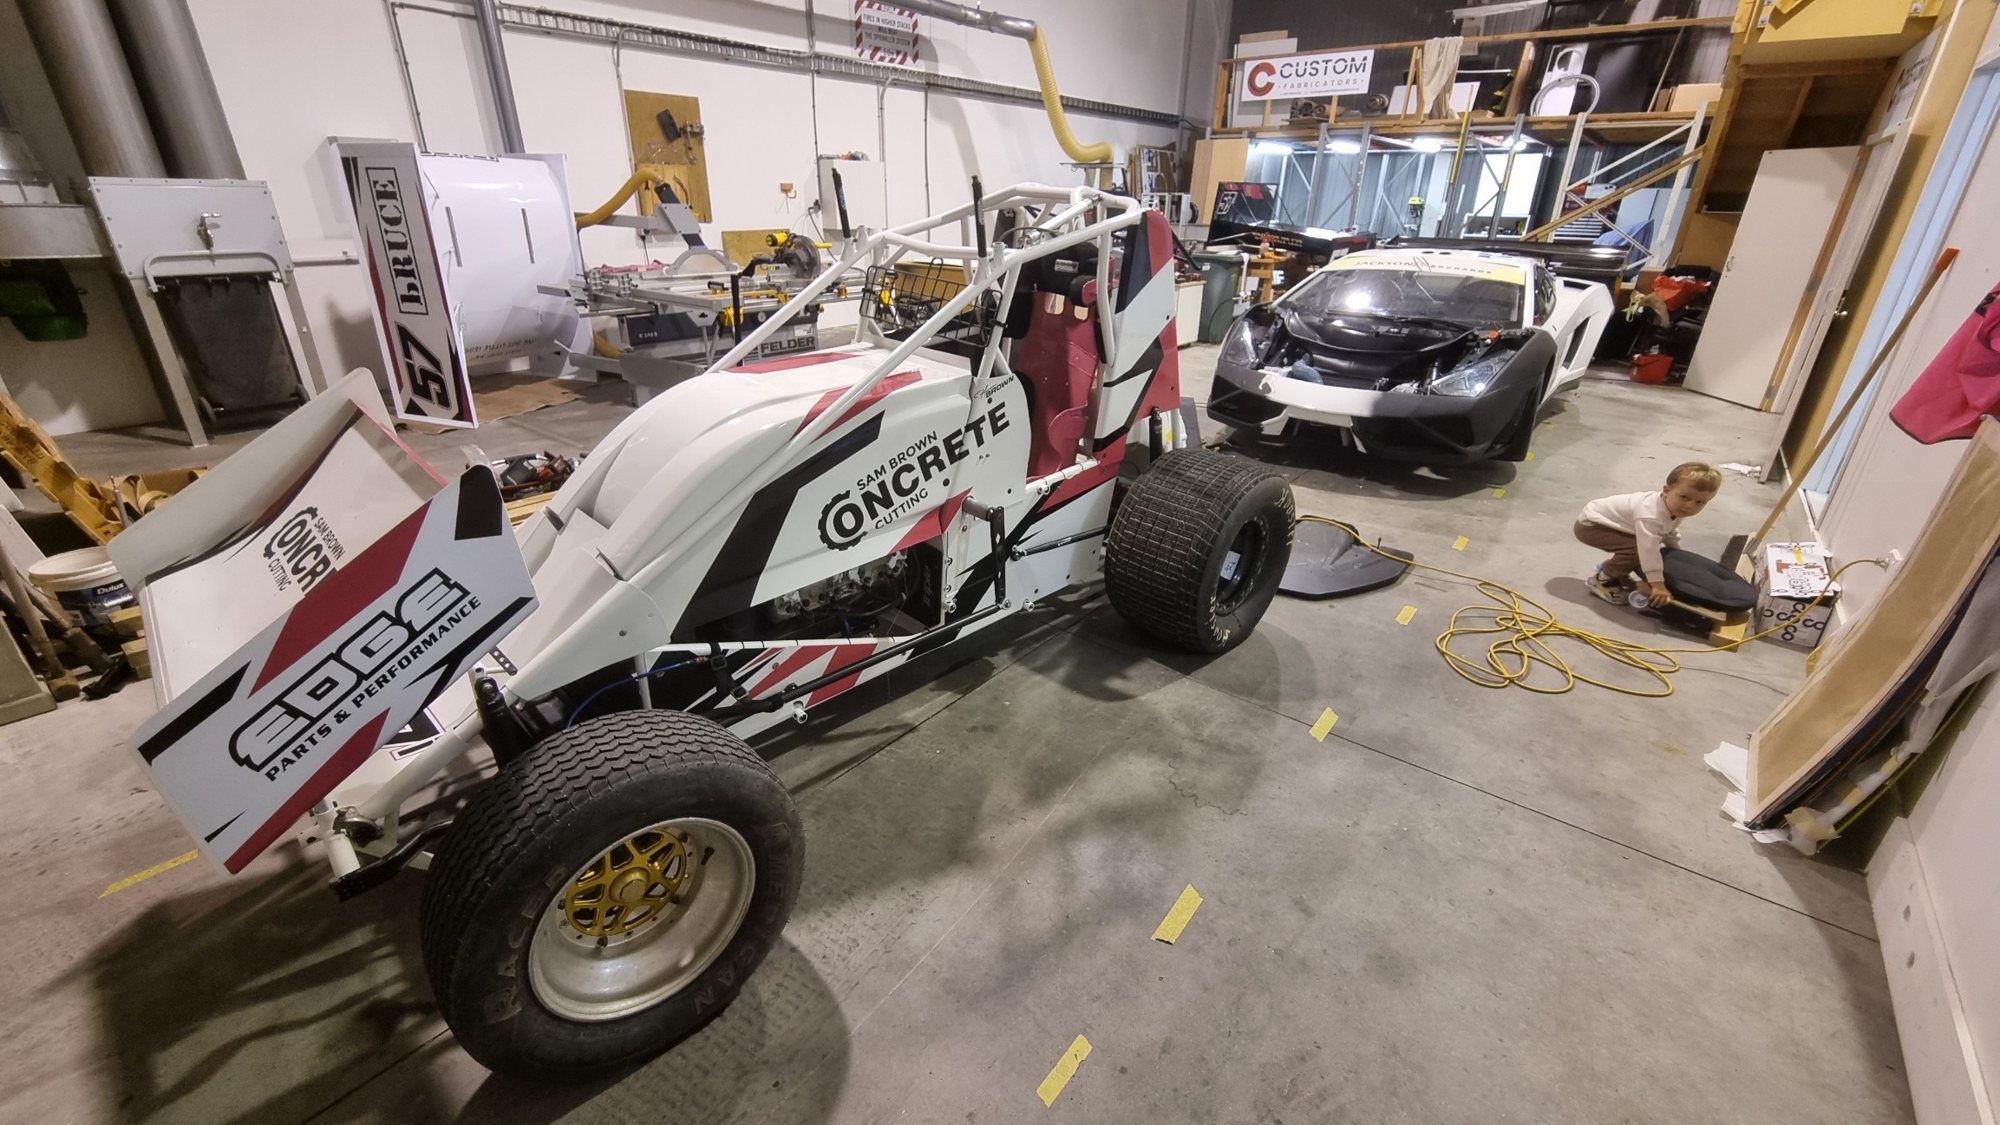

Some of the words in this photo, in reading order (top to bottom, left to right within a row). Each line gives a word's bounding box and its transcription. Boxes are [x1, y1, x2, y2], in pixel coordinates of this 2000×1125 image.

[1280, 56, 1368, 78] CUSTOM
[395, 321, 452, 410] 57
[761, 336, 815, 353] FELDER
[985, 375, 1014, 398] BROWN
[856, 464, 887, 490] SAM
[889, 430, 938, 470] BROWN
[875, 488, 929, 530] CUTTING
[314, 517, 330, 537] SAM
[322, 529, 345, 560] BROWN
[96, 582, 124, 595] Dulux
[268, 558, 292, 591] CUTTING
[228, 566, 471, 772] EDGE
[264, 723, 332, 782] PARTS
[334, 709, 351, 724] &
[351, 596, 482, 708] PERFORMANCE
